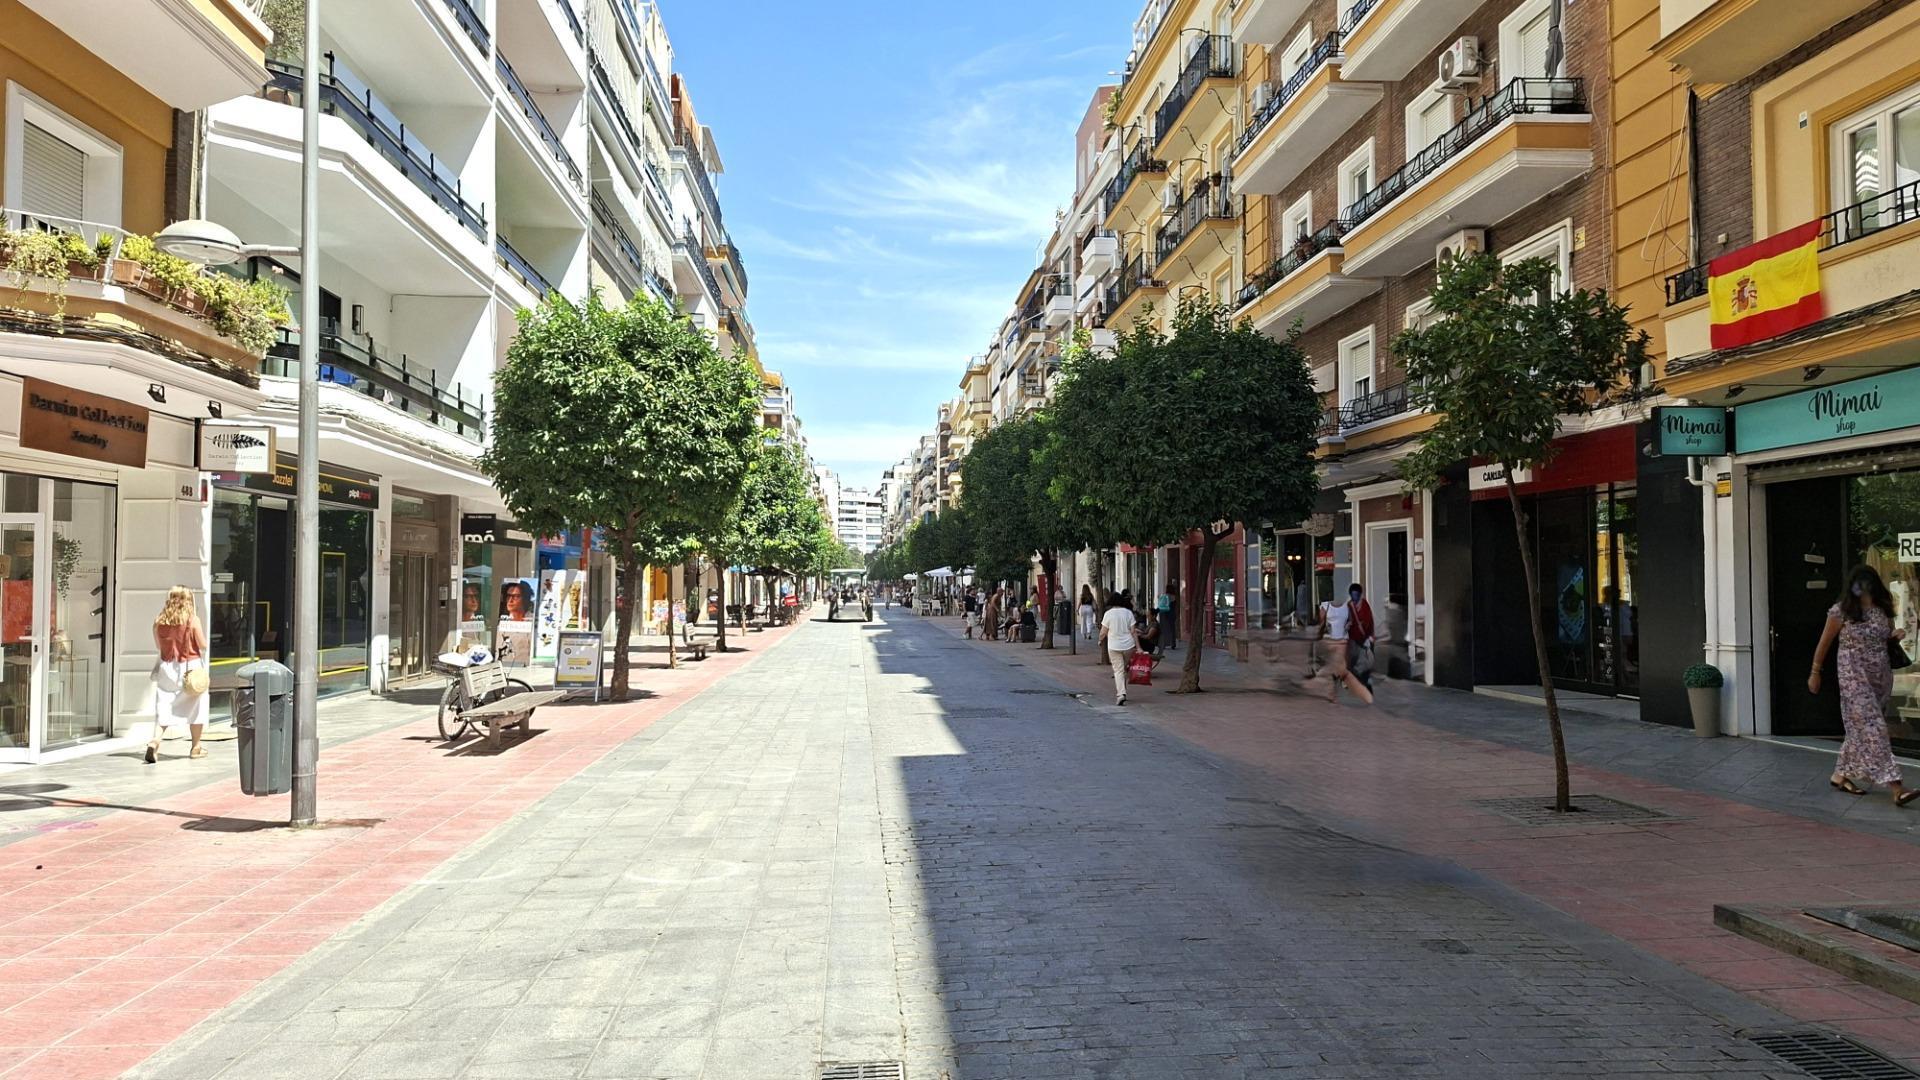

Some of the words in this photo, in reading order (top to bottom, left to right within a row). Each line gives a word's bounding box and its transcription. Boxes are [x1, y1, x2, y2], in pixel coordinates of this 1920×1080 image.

[1808, 385, 1883, 420] Mimai
[29, 393, 79, 417] Darwin
[80, 405, 147, 433] Collection
[1660, 414, 1725, 434] Mimai
[1836, 418, 1856, 434] shop
[1685, 435, 1702, 447] shop
